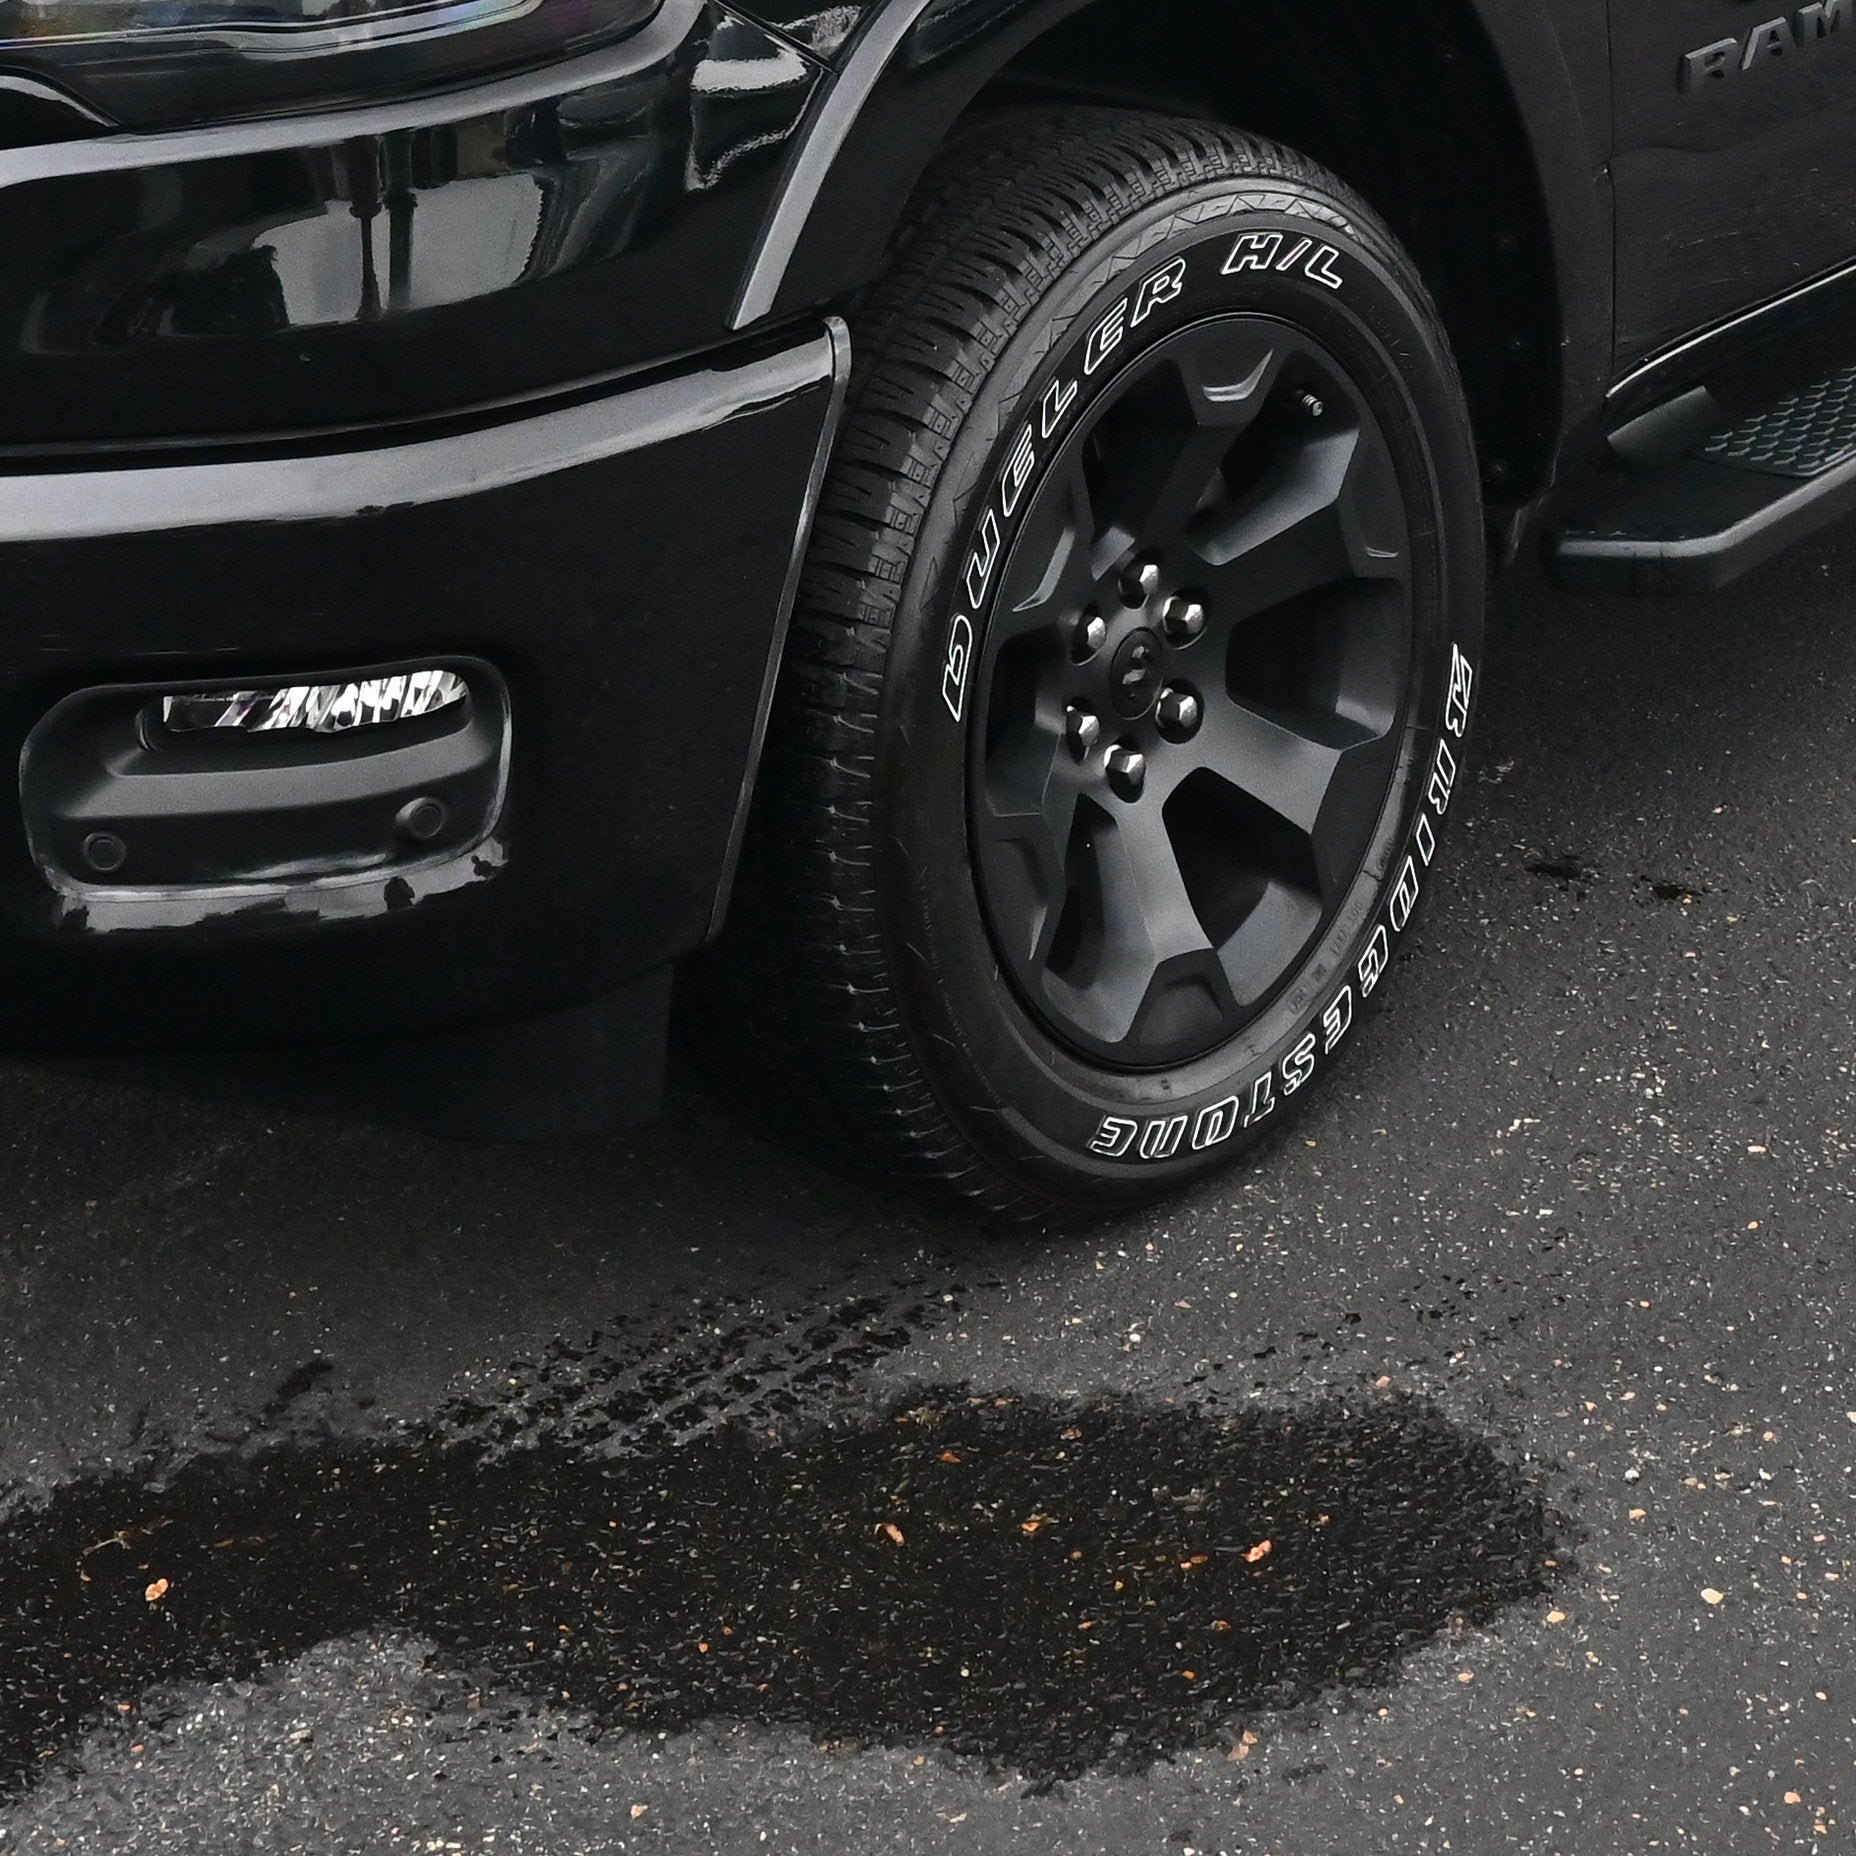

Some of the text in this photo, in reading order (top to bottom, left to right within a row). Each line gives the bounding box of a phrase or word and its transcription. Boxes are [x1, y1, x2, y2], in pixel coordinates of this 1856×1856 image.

[943, 233, 1343, 722] DUELER H/L
[1088, 643, 1473, 1159] BRIDGESTONE
